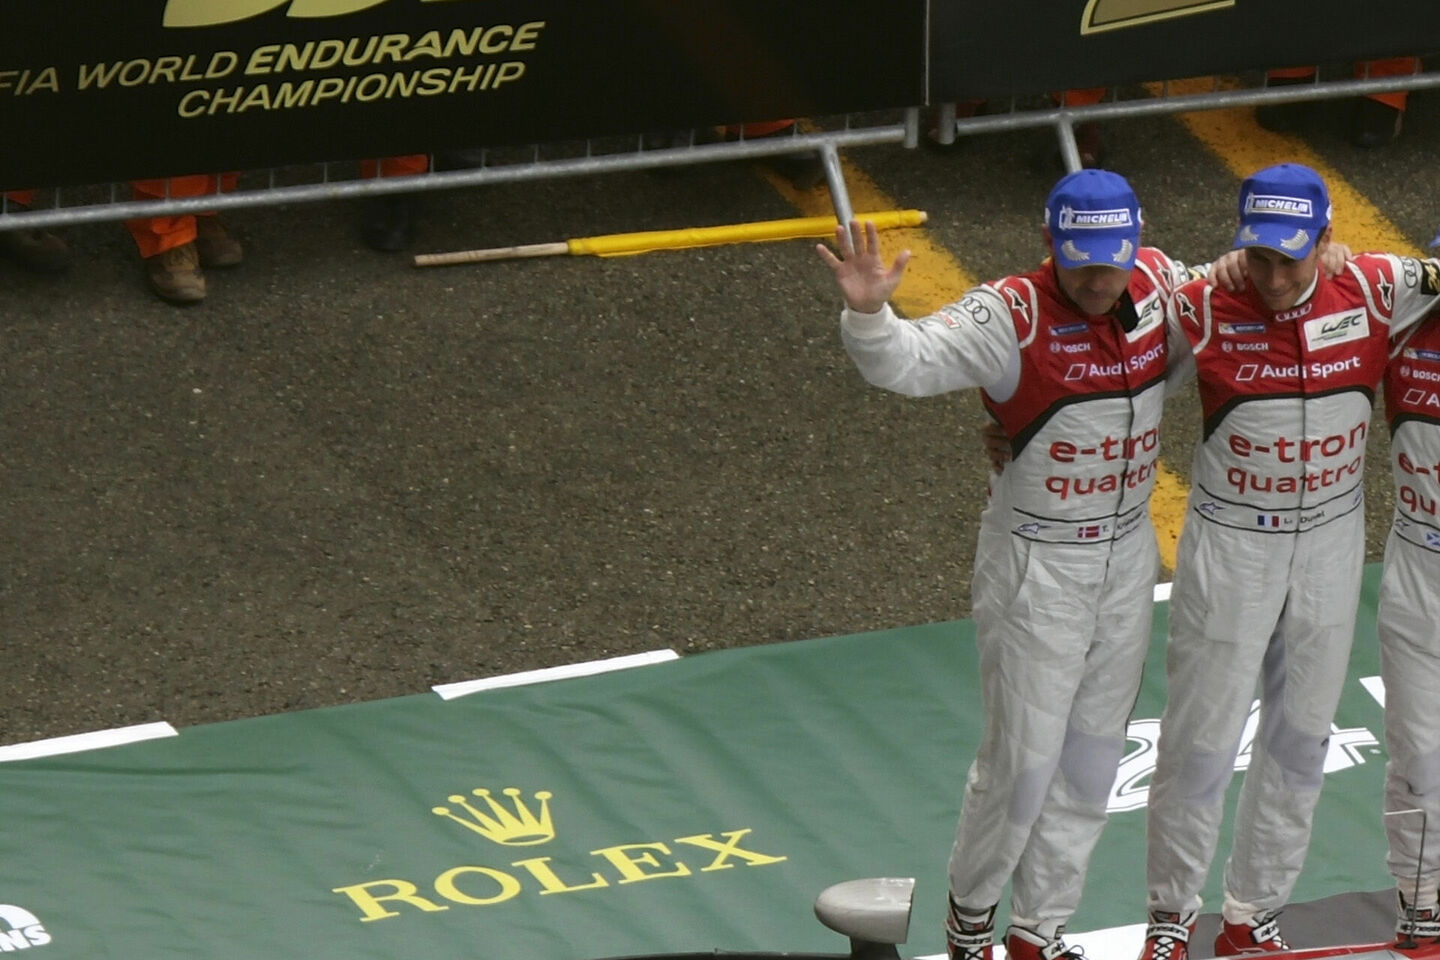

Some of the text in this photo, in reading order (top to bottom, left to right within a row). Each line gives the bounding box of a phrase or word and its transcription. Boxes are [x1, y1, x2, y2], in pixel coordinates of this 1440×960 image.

[0, 20, 546, 96] FIA WORLD ENDURANCE
[177, 60, 526, 118] CHAMPIONSHIP
[1075, 212, 1128, 224] MICHELIN
[1256, 198, 1309, 214] MICHELIN
[1321, 313, 1363, 334] WEC
[1089, 343, 1164, 377] Audi Sport
[1237, 342, 1269, 351] BOSCH
[1260, 355, 1361, 380] Audi Sport
[1049, 426, 1161, 462] e-tro
[1229, 421, 1367, 463] e-tron
[1045, 459, 1158, 500] quattr
[1227, 456, 1362, 495] quattro
[332, 828, 787, 923] ROLEX
[0, 924, 52, 952] NS
